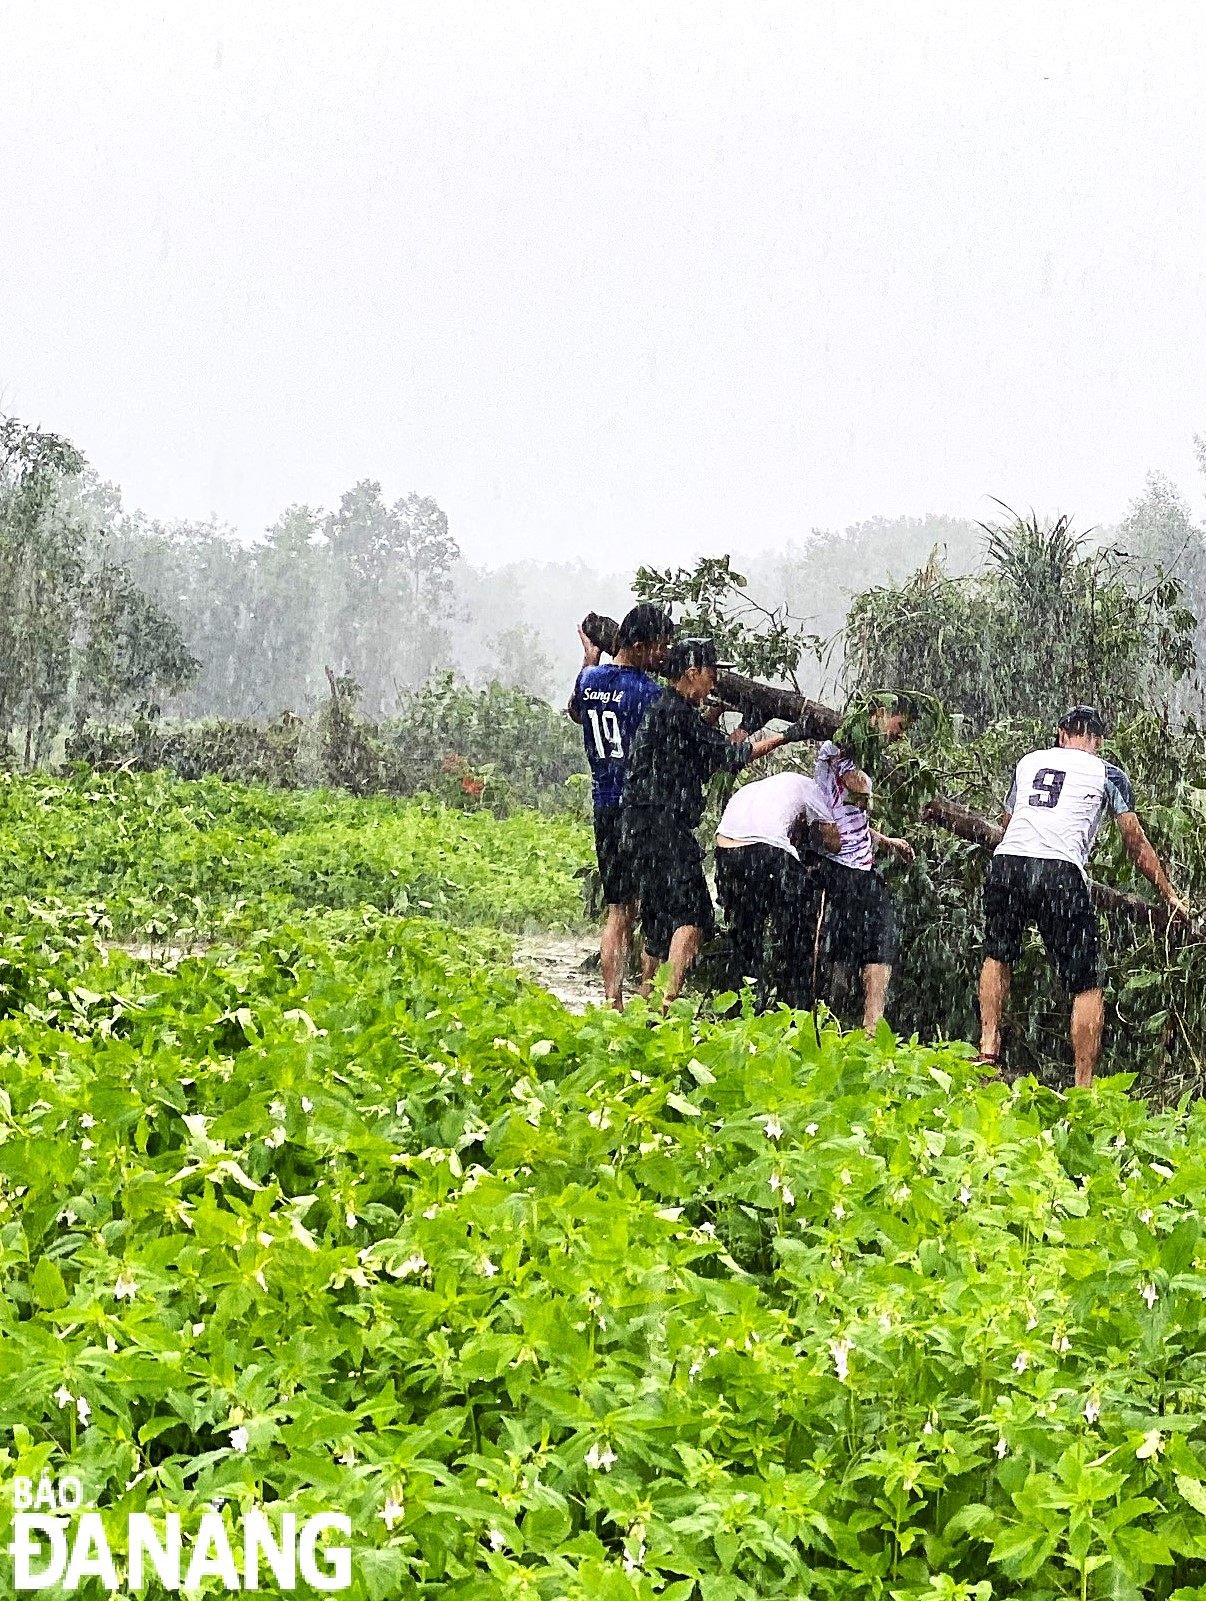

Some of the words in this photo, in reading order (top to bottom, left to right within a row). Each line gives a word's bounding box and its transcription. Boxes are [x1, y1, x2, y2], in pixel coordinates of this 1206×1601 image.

[583, 688, 611, 704] Sang
[588, 709, 624, 759] 19
[1029, 768, 1067, 808] 9
